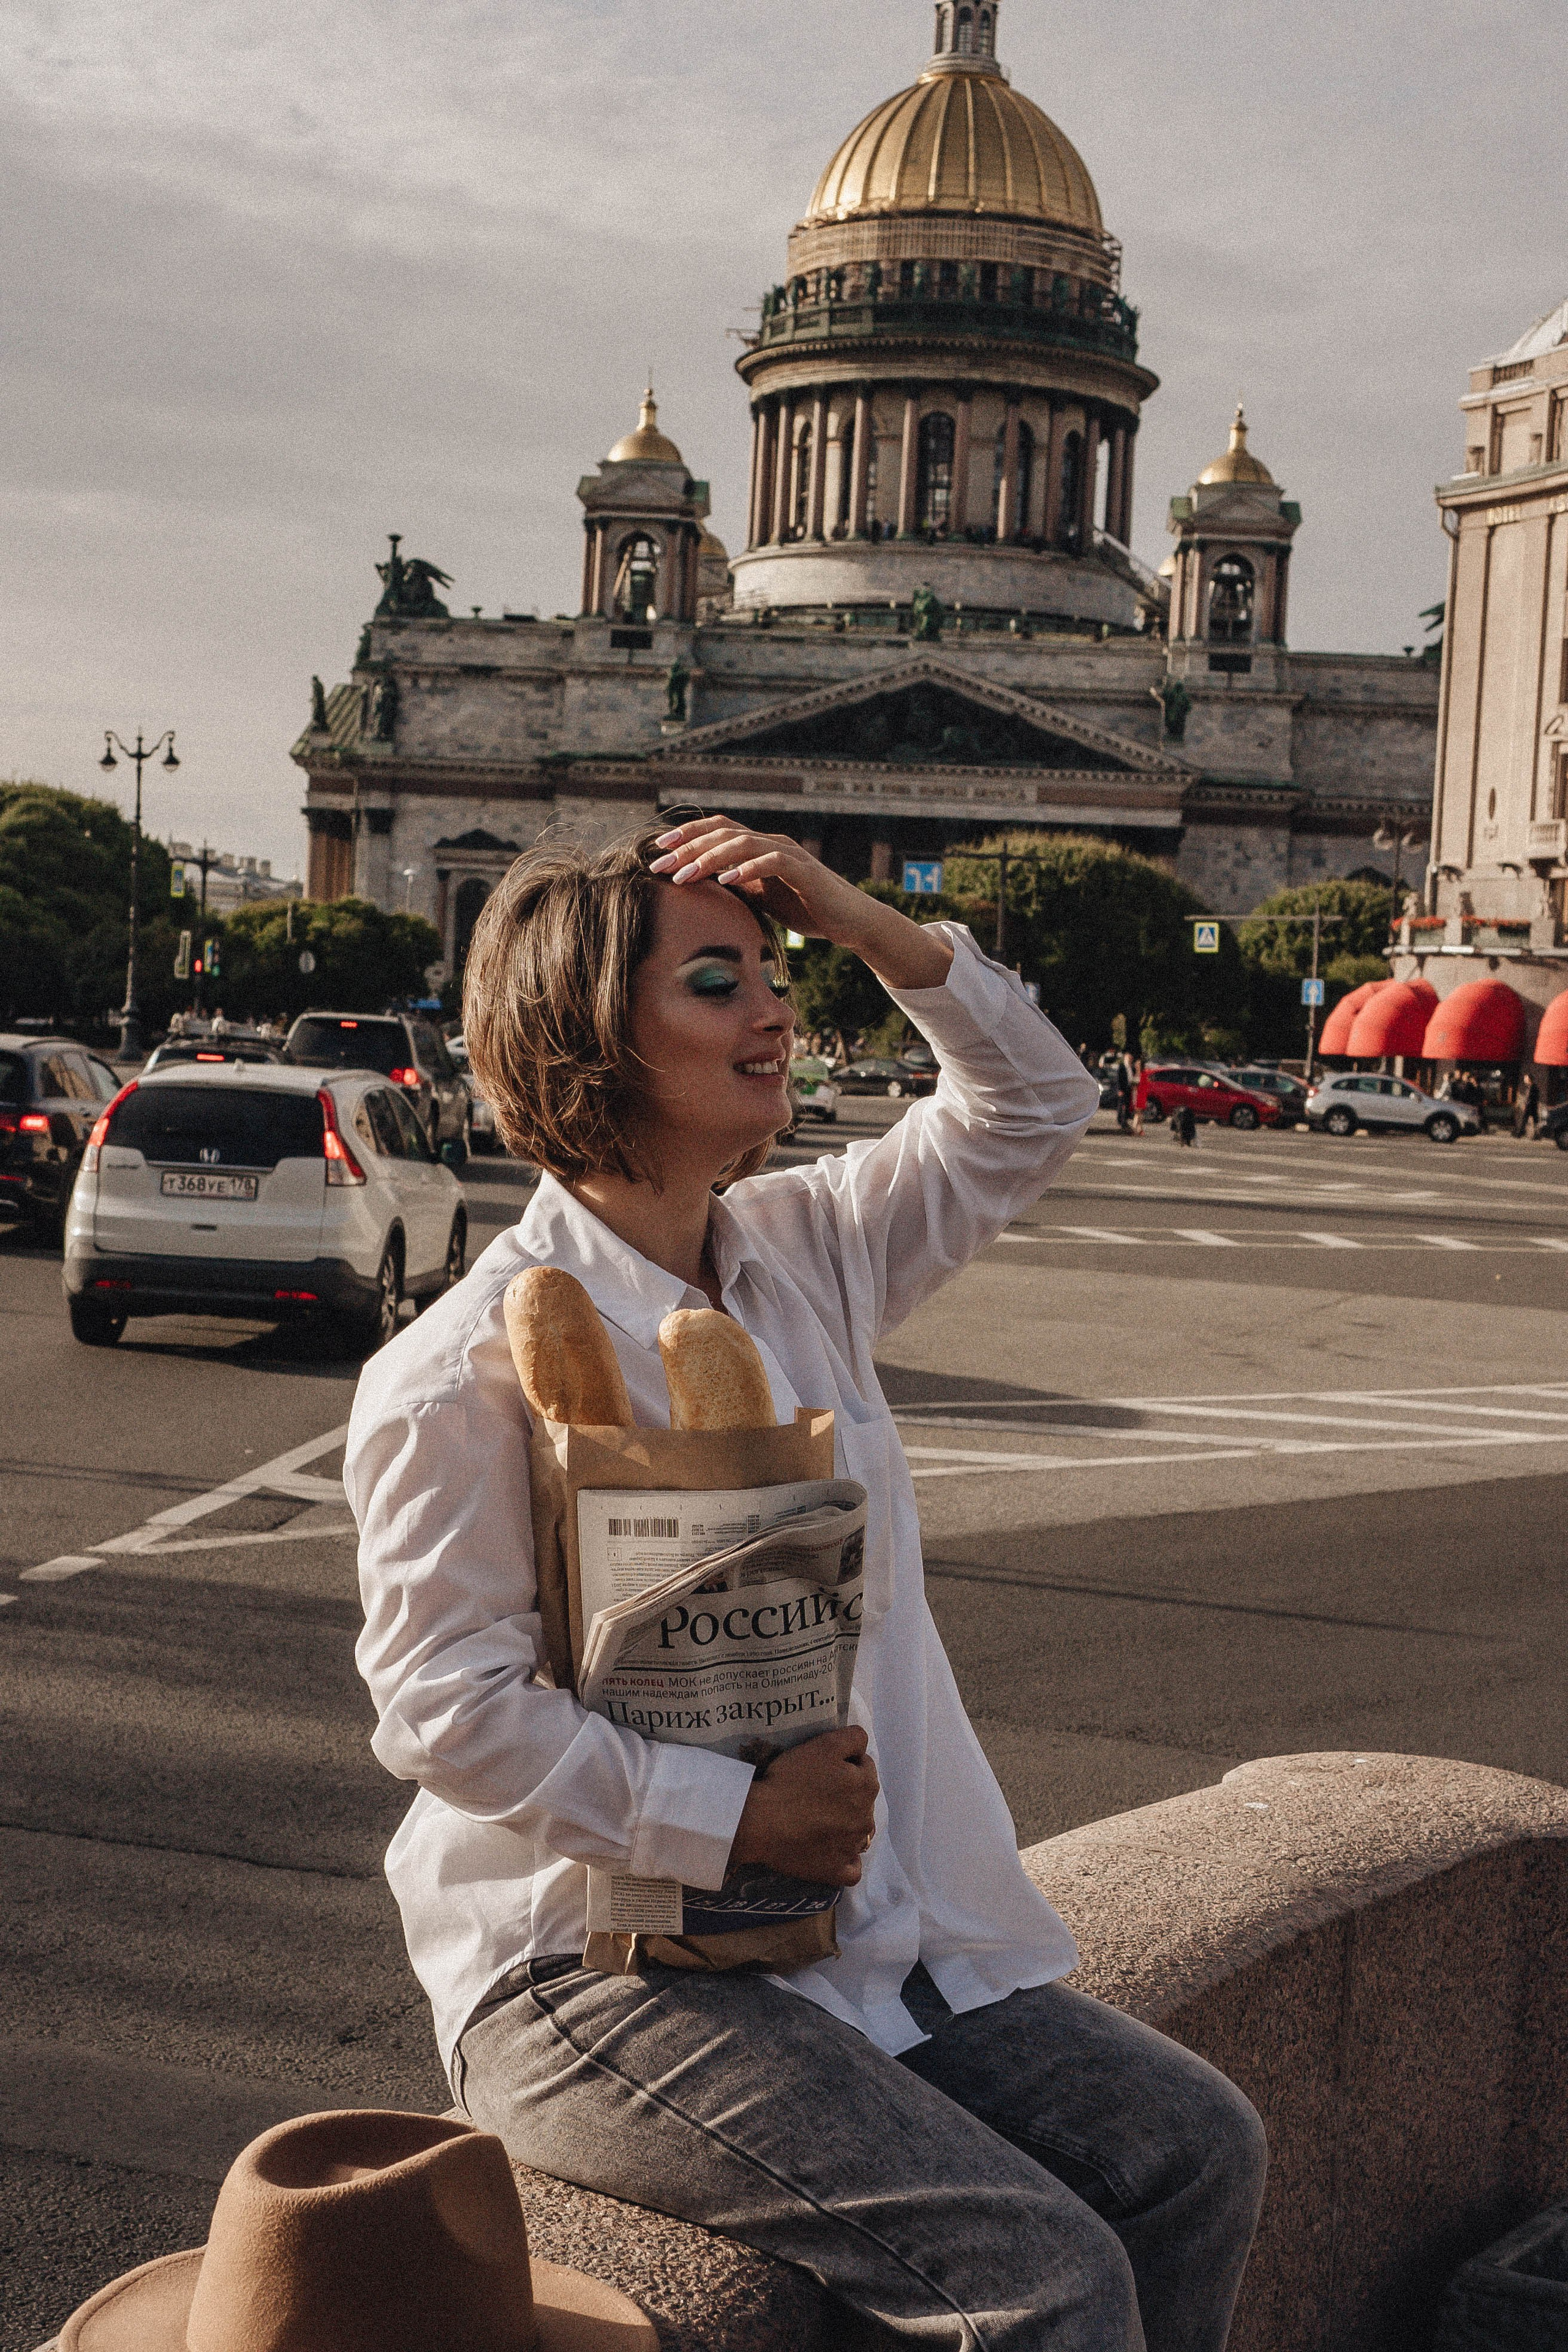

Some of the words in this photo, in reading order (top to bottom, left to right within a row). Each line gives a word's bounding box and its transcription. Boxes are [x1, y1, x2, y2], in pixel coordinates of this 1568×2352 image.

[668, 1677, 697, 1687] МОК
[699, 1676, 711, 1684] не
[713, 1670, 769, 1684] допускает
[772, 1659, 815, 1677] россиян
[816, 1653, 827, 1665] на
[602, 1688, 640, 1697] нашим
[643, 1689, 699, 1700] надеждам
[701, 1683, 742, 1697] попасть
[747, 1680, 758, 1689] на
[605, 1698, 712, 1735] Париж
[715, 1689, 835, 1727] закрыт...
